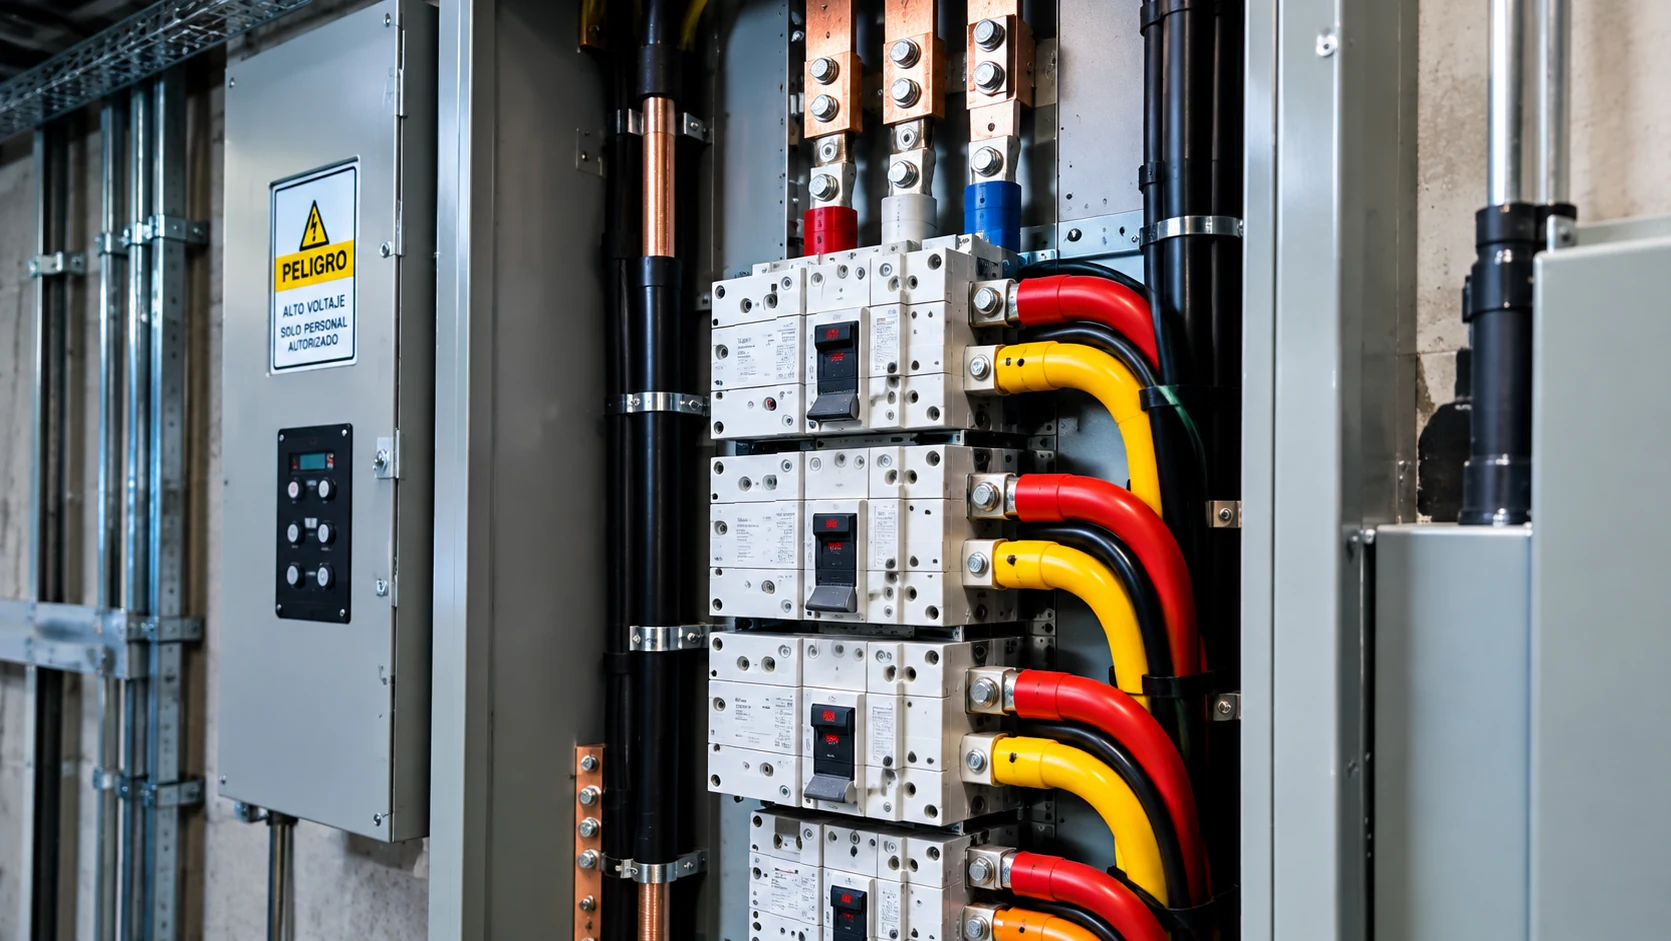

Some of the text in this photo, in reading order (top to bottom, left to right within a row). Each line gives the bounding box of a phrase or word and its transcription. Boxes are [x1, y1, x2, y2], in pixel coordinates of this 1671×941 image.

[283, 250, 347, 282] PELIGRO
[283, 294, 345, 318] ALTO VOLTAJE
[281, 316, 347, 338] SOLO PERSONAL
[288, 334, 338, 352] AUTORIZADO
